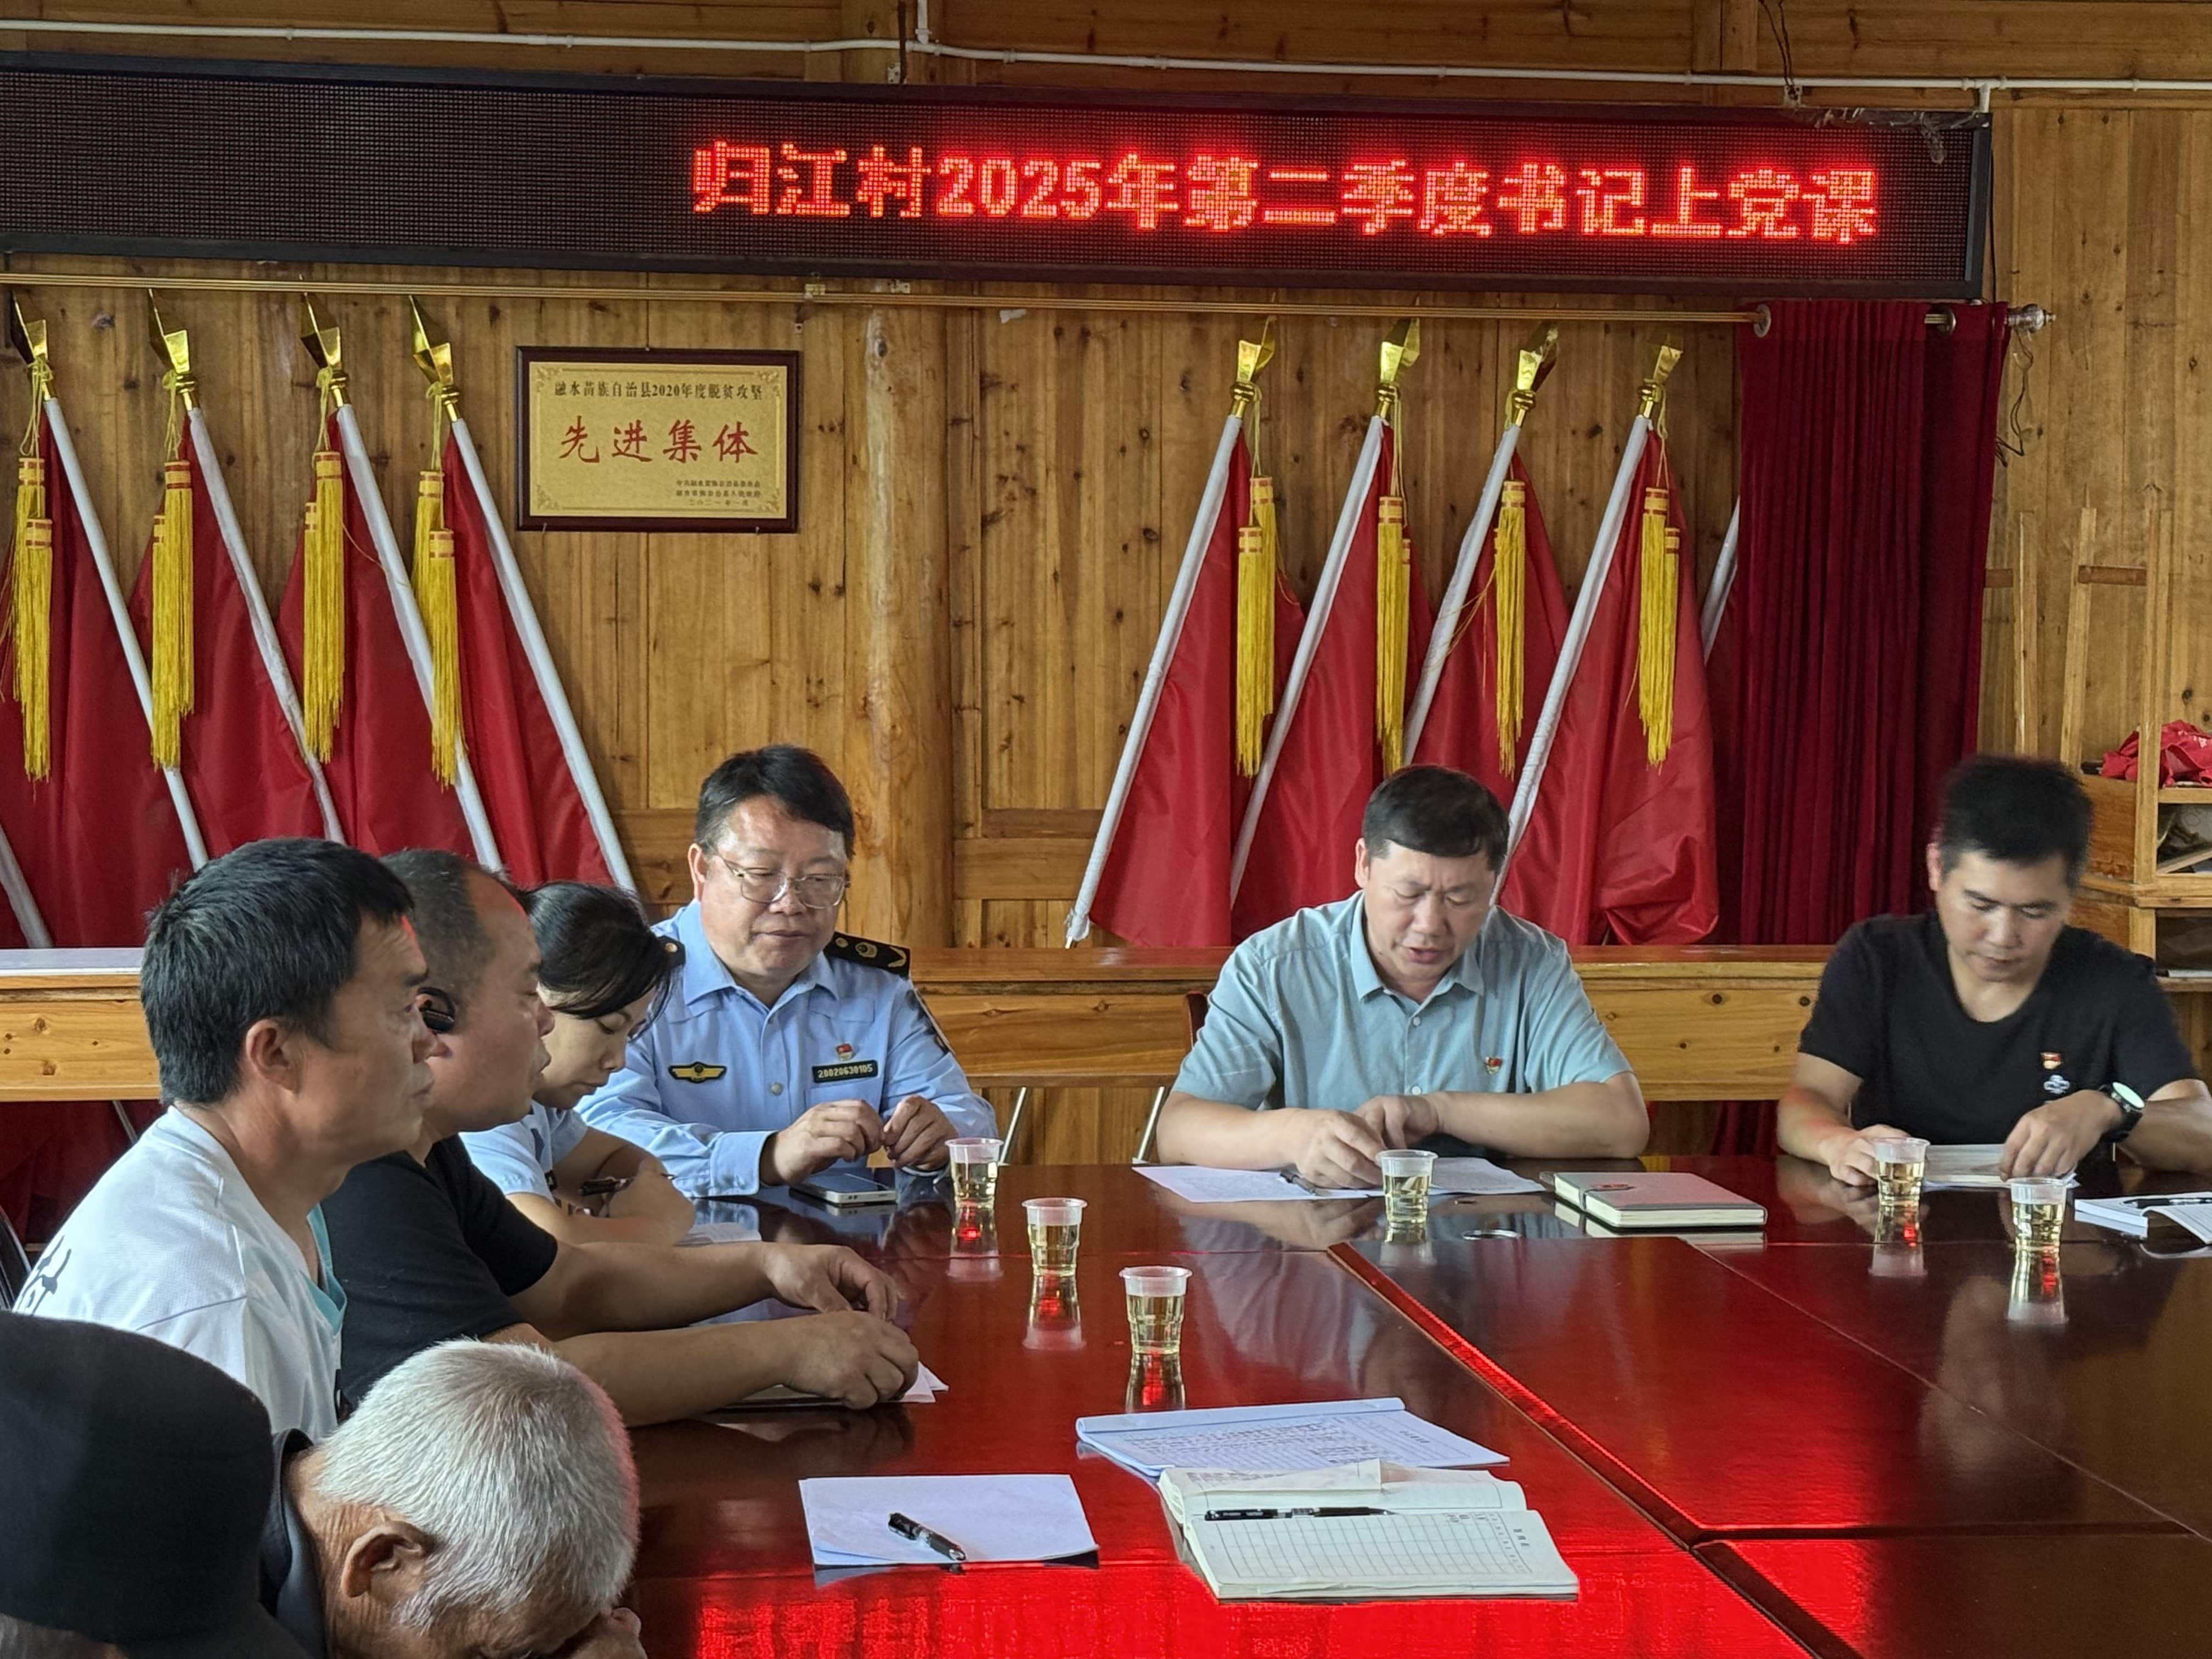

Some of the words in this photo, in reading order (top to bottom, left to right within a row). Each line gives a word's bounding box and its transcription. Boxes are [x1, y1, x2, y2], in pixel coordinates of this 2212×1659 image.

[693, 141, 1876, 244] 归江村2025年第二季度书记上党课
[554, 381, 763, 400] 融水苗族自治县2020年度脱贫攻坚
[558, 415, 758, 463] 先进集体
